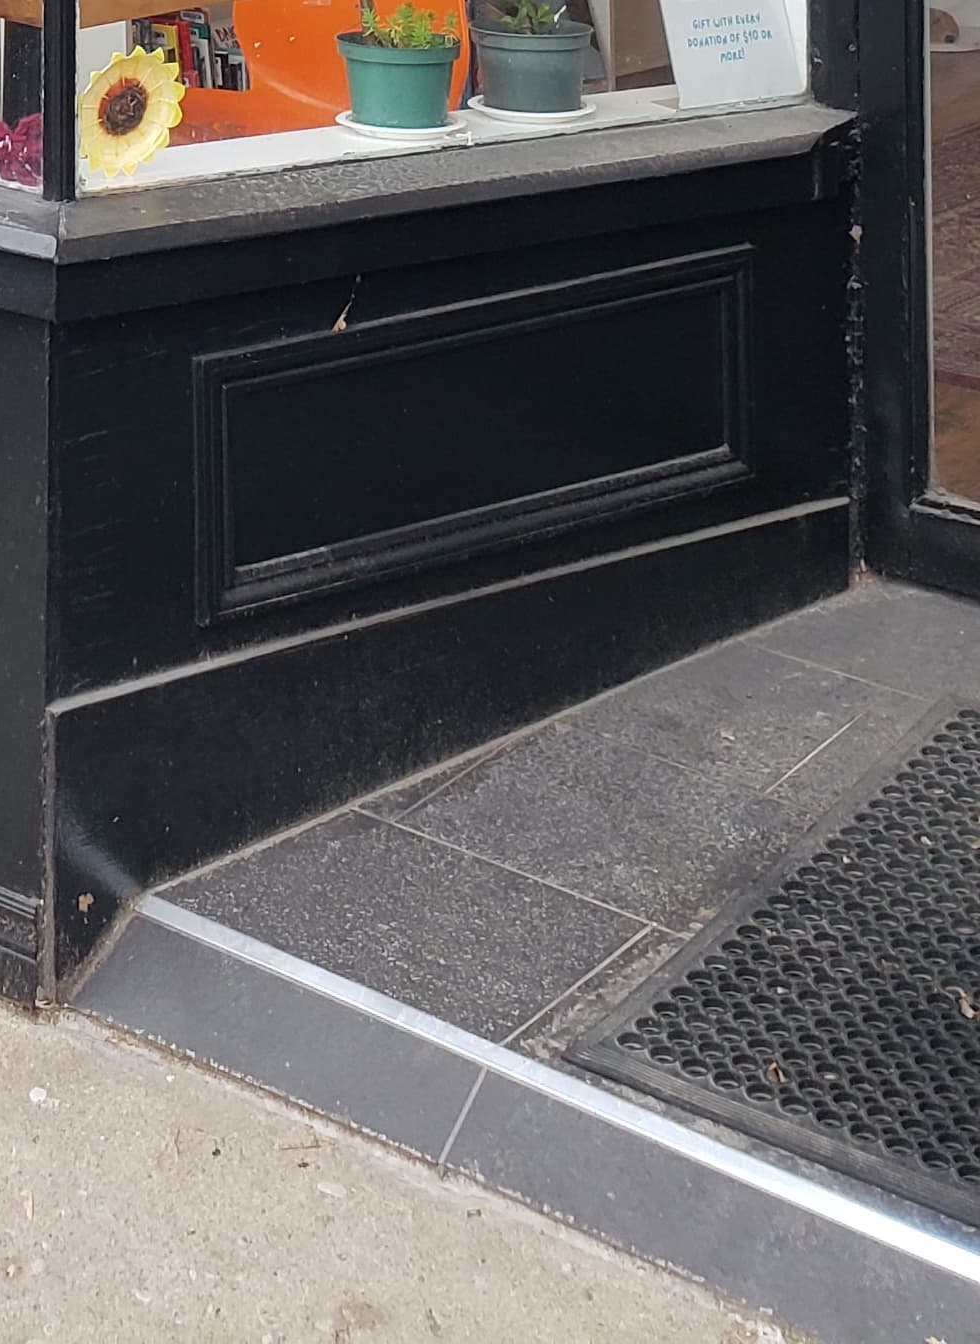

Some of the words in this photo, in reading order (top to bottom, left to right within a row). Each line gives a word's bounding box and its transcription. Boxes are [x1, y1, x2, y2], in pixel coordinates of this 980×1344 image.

[692, 18, 710, 30] GIFT
[713, 16, 733, 28] WITH
[735, 12, 760, 25] EVERY
[687, 35, 728, 48] DONATION
[729, 32, 740, 43] OF
[743, 29, 759, 44] $10
[761, 29, 773, 39] OR
[720, 46, 745, 63] MORE!
